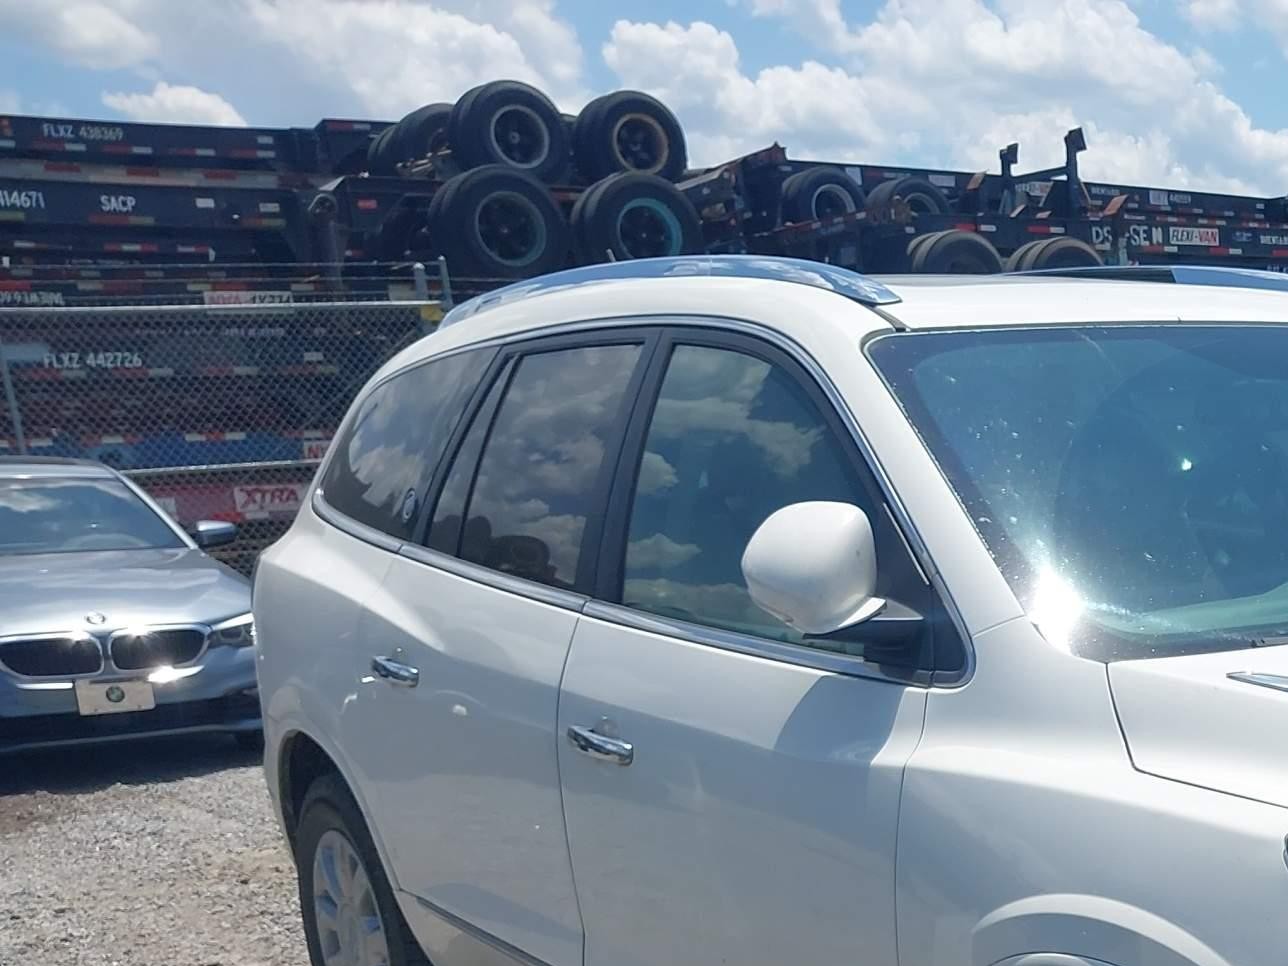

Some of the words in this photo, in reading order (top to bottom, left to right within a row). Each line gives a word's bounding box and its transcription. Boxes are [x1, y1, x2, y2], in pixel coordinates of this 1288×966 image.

[42, 123, 74, 138] FLXZ
[100, 195, 136, 212] SACP
[1171, 229, 1218, 244] FLEXI-VAN
[44, 351, 81, 369] FLXZ
[86, 353, 142, 369] 442726
